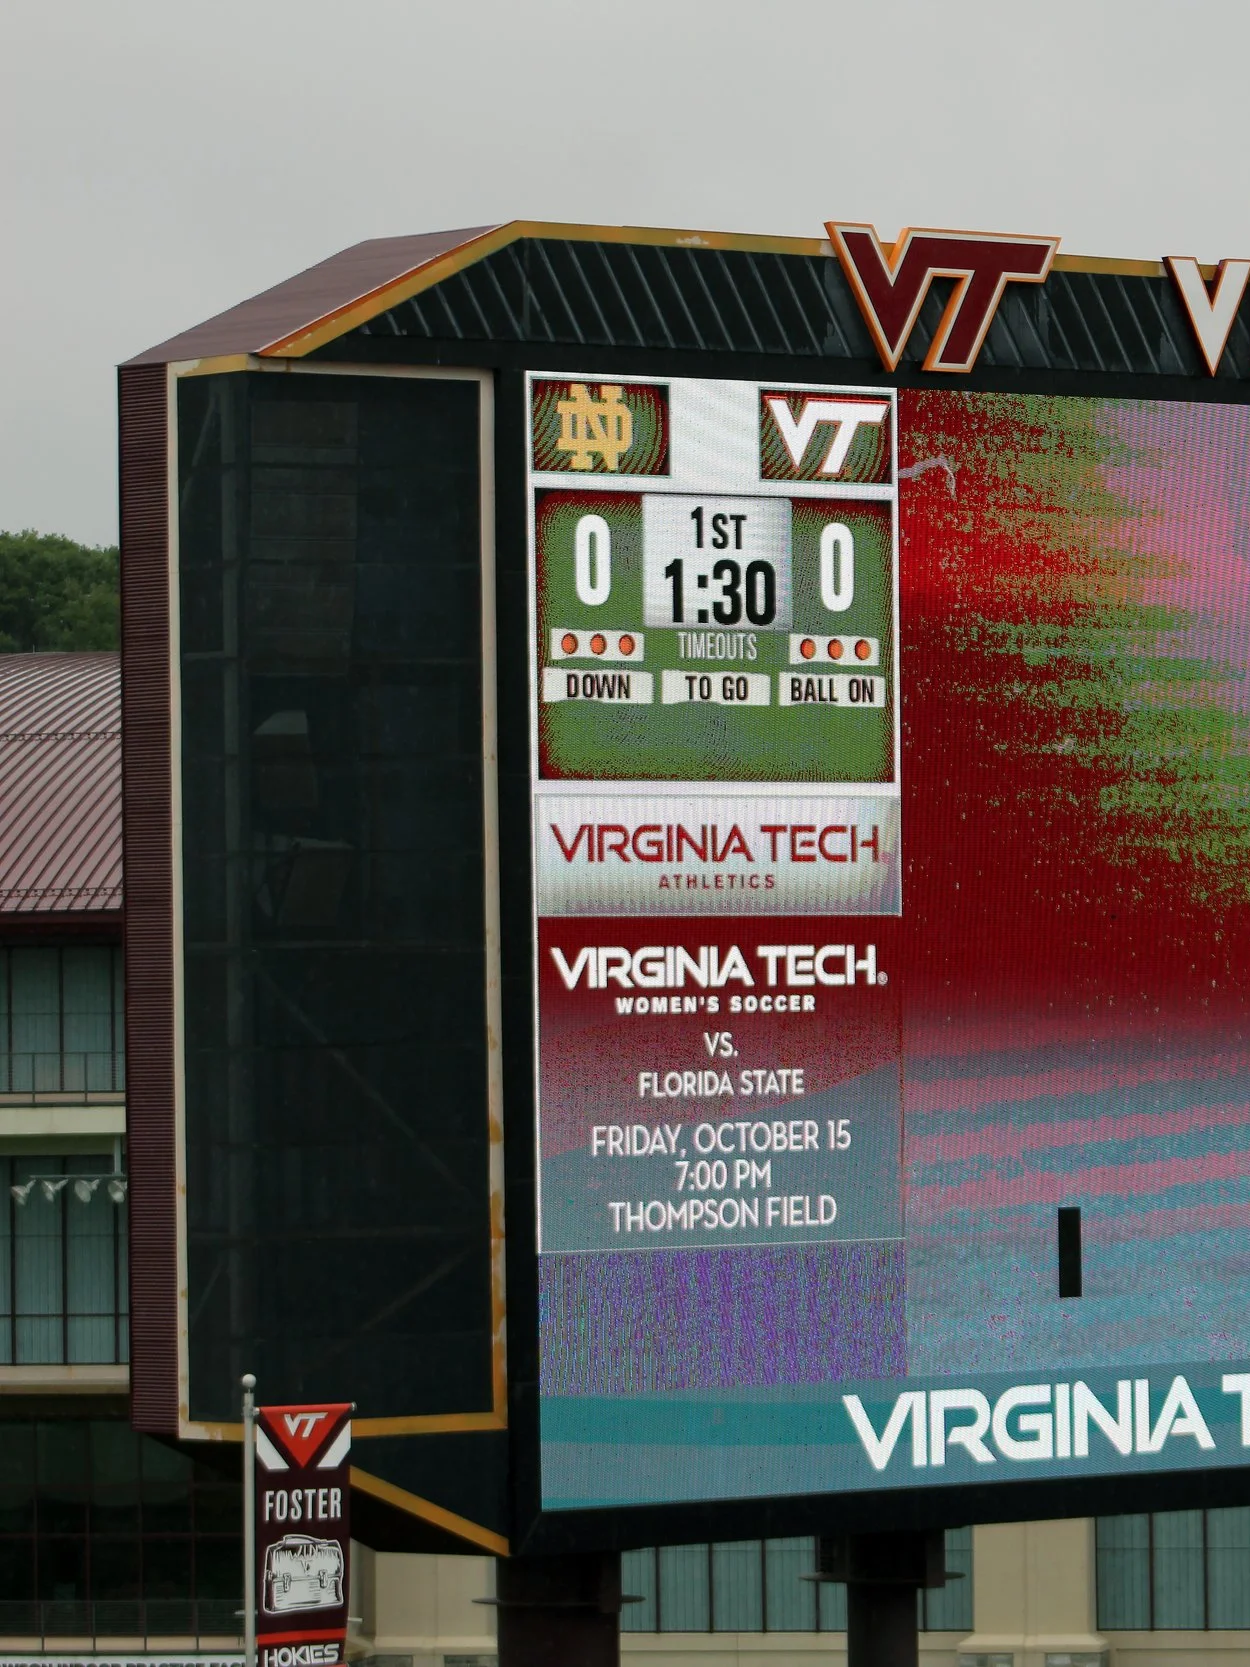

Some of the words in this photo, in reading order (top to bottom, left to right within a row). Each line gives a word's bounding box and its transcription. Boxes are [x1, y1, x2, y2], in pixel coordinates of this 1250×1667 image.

[824, 221, 1061, 373] VT
[765, 398, 890, 474] VT
[690, 506, 746, 550] 1ST
[575, 514, 611, 606] 0
[820, 522, 854, 612] 0
[664, 558, 777, 626] 1:30
[678, 630, 757, 660] TIMEOUTS
[566, 674, 630, 699] DOWN
[685, 676, 711, 700] TO
[722, 677, 749, 701] GO
[791, 677, 838, 702] BALL
[848, 678, 874, 703] ON
[550, 824, 754, 863] VIRGINIA
[760, 824, 880, 863] TECH
[658, 873, 776, 890] ATHLETICS
[550, 945, 754, 990] VIRGINIA
[615, 995, 720, 1015] WOMEN'S
[730, 994, 816, 1012] SOCCER
[704, 1032, 738, 1058] VS.
[638, 1071, 734, 1099] FLORIDA
[740, 1069, 804, 1096] STATE
[591, 1123, 687, 1158] FRIDAY,
[693, 1120, 819, 1155] OCTOBER
[828, 1119, 851, 1150] 15
[675, 1160, 728, 1191] 7:00
[735, 1159, 772, 1190] PM
[608, 1198, 759, 1232] THOMPSON
[767, 1195, 837, 1227] FIELD
[284, 1412, 327, 1438] VT
[842, 1374, 1216, 1472] VIRGINIA
[265, 1487, 341, 1521] FOSTER
[264, 1643, 339, 1667] HOKIES
